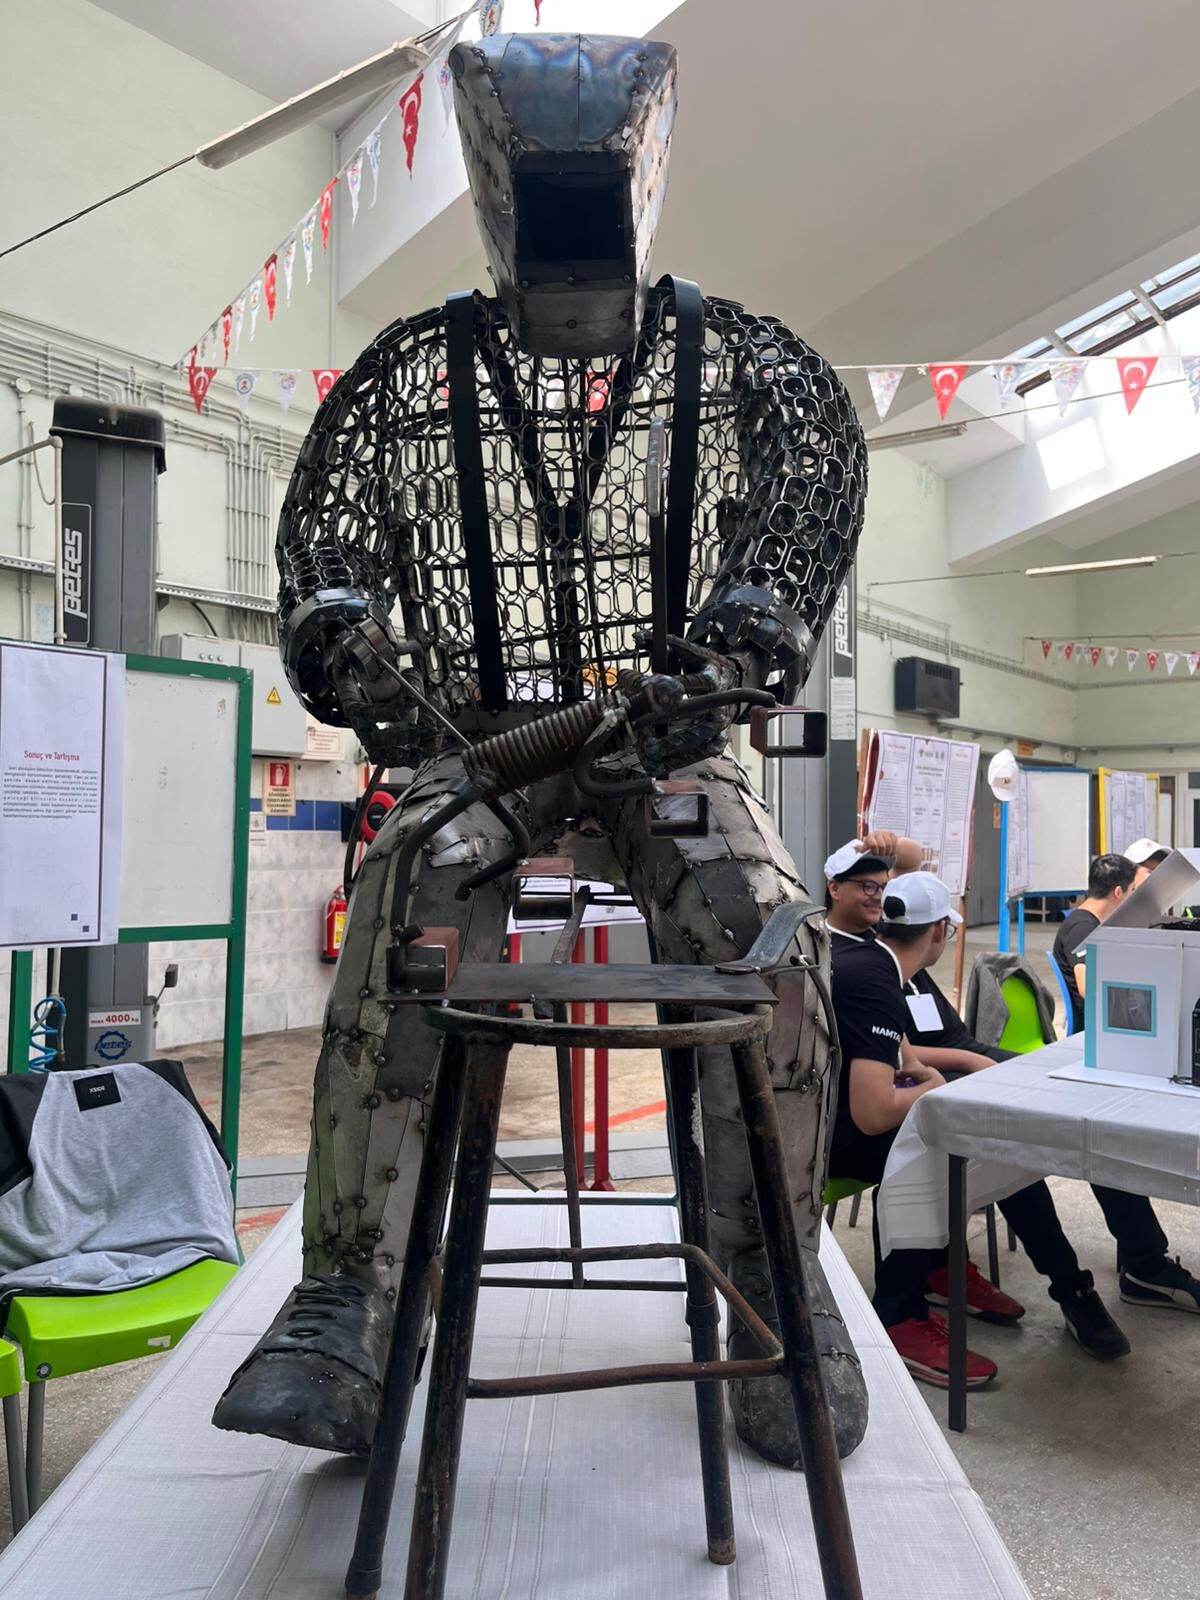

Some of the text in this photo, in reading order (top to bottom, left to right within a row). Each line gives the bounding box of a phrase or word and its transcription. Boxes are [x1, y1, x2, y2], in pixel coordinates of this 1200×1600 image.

[64, 527, 88, 619] petes
[24, 750, 43, 760] Sonuç
[54, 752, 80, 763] Tartışma
[105, 1014, 130, 1023] 4000
